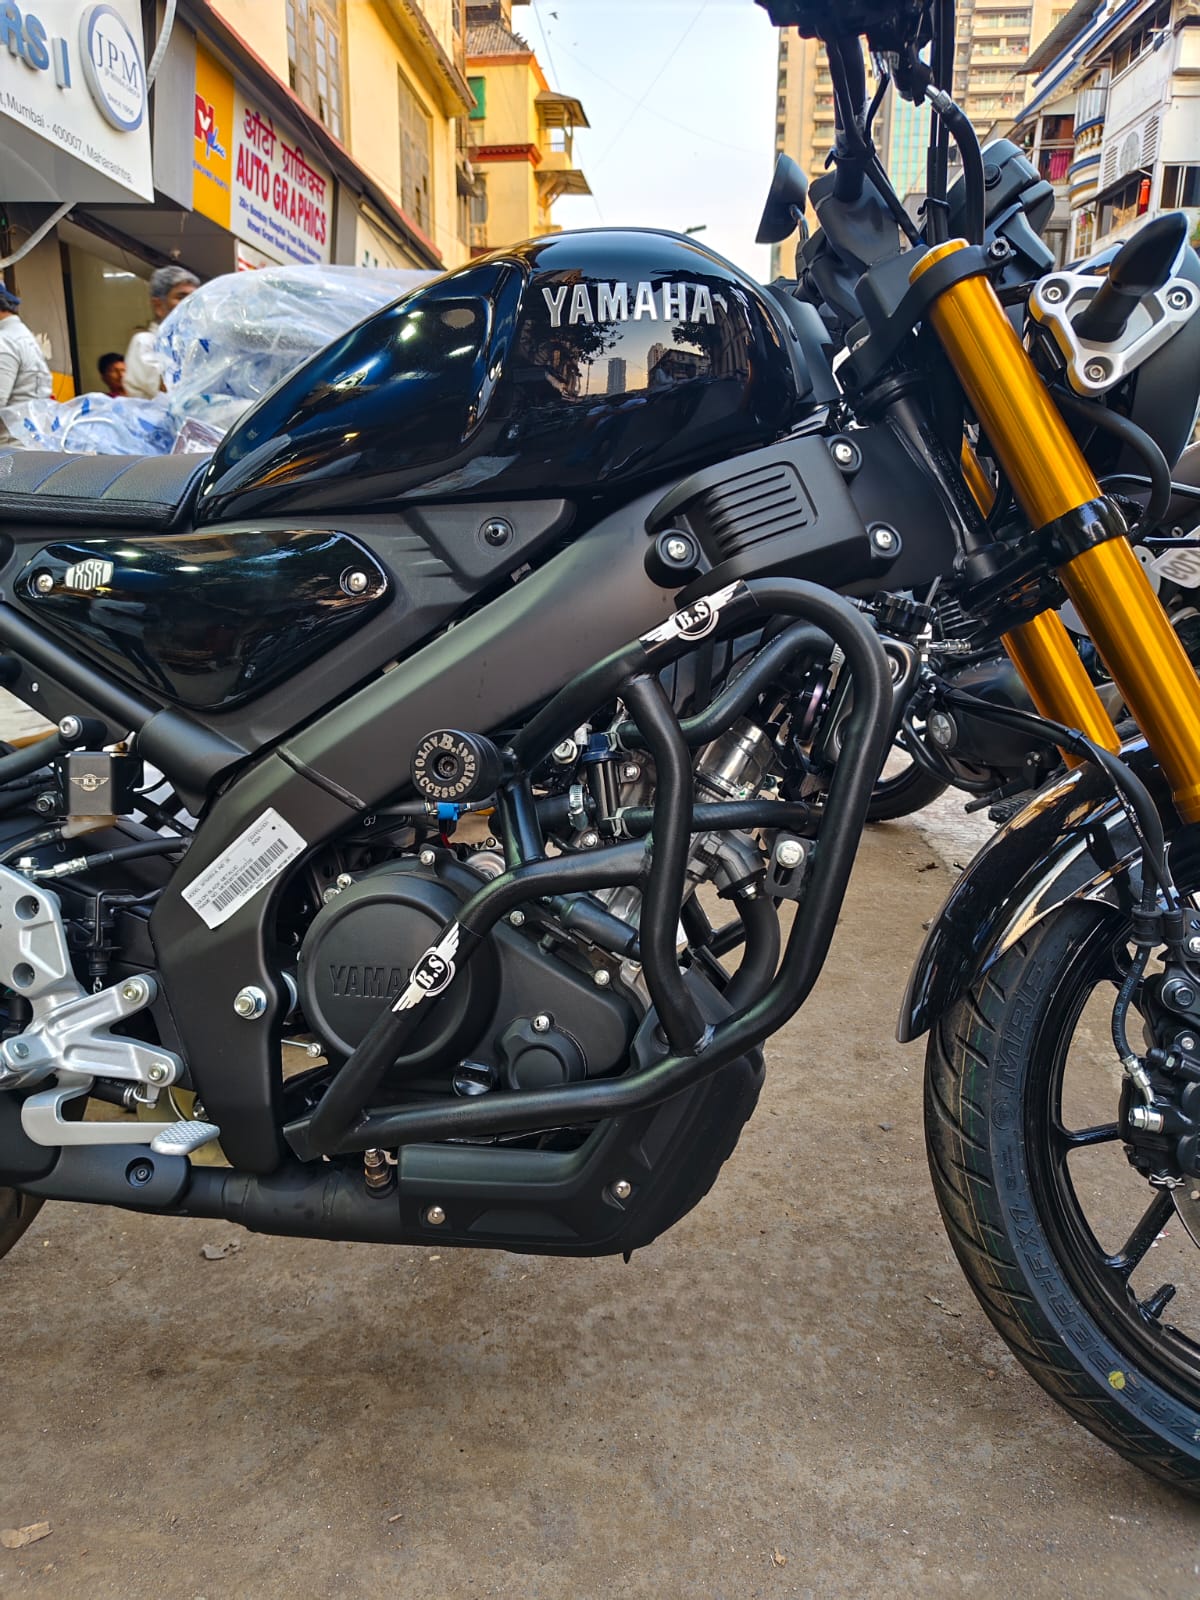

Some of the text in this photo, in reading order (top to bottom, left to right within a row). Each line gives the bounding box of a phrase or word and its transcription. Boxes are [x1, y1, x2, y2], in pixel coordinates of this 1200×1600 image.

[96, 30, 139, 89] JPM
[7, 92, 45, 127] Mumbai
[237, 143, 270, 203] AUTO
[273, 173, 327, 247] GRAPHICS
[542, 281, 716, 328] YAMAHA
[74, 560, 104, 590] XSR
[676, 601, 711, 632] B.S
[415, 753, 476, 799] ACCESSORIES
[329, 965, 413, 998] YAMA
[416, 955, 445, 989] B.S
[994, 966, 1044, 1090] MRF
